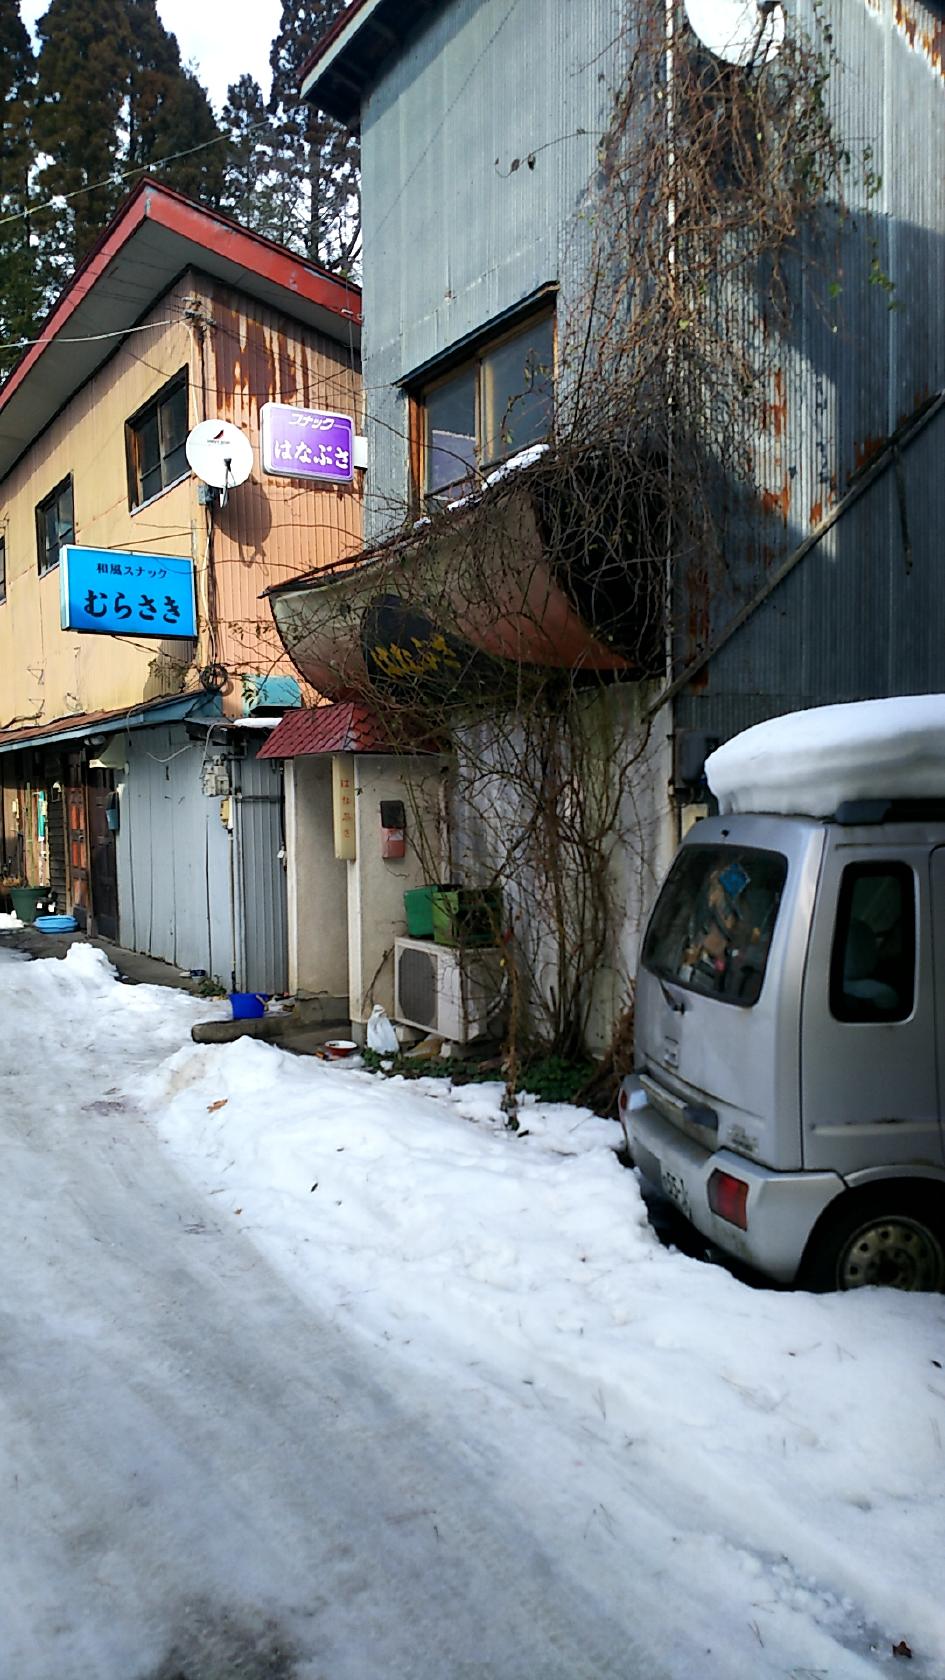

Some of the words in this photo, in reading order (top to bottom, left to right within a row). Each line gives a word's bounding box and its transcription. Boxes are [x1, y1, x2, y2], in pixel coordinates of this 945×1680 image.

[288, 413, 334, 431] スナック
[274, 439, 349, 469] はなぶさ
[96, 563, 167, 579] 和風スナック
[84, 589, 181, 624] むらさき
